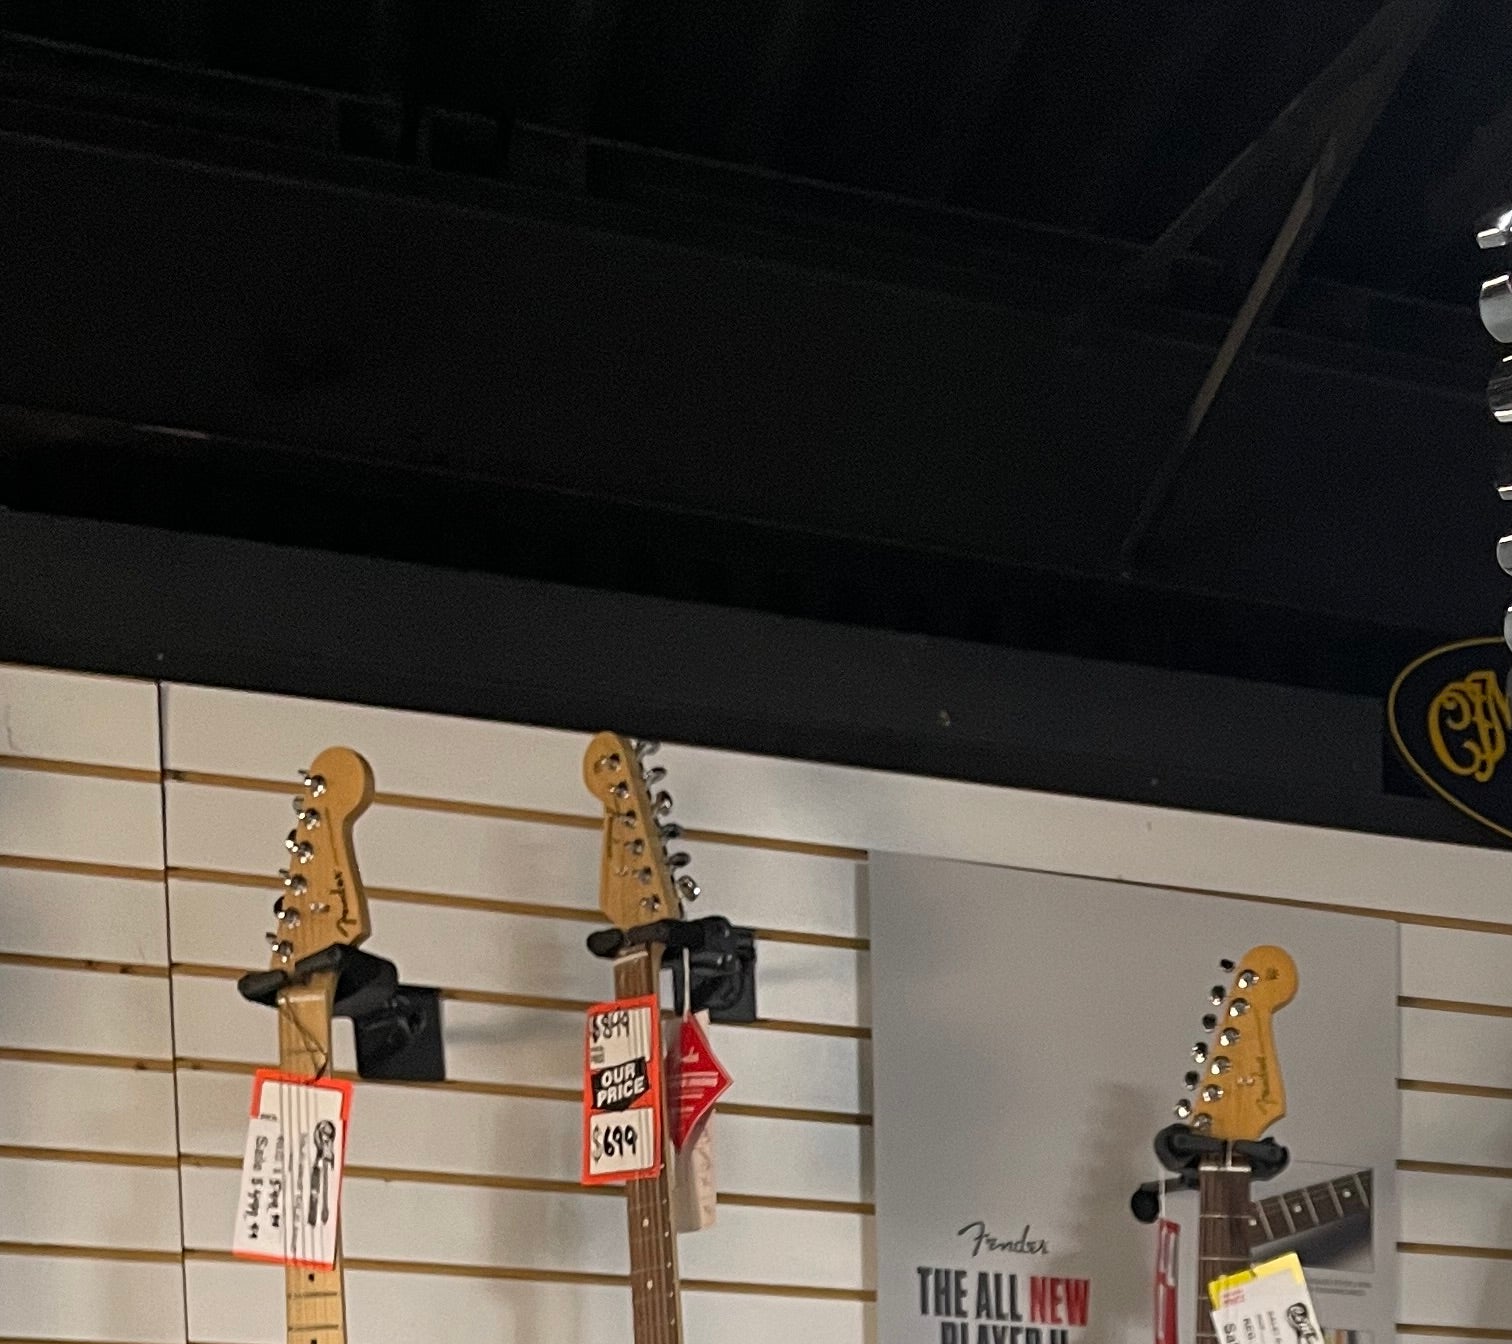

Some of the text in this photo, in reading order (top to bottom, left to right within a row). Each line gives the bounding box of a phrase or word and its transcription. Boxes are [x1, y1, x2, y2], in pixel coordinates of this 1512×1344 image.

[596, 1075, 645, 1108] PRICE
[601, 1063, 635, 1086] OUR
[592, 1125, 637, 1162] $699
[958, 1221, 1048, 1256] Fender
[917, 1266, 1090, 1326] THE ALL NEW
